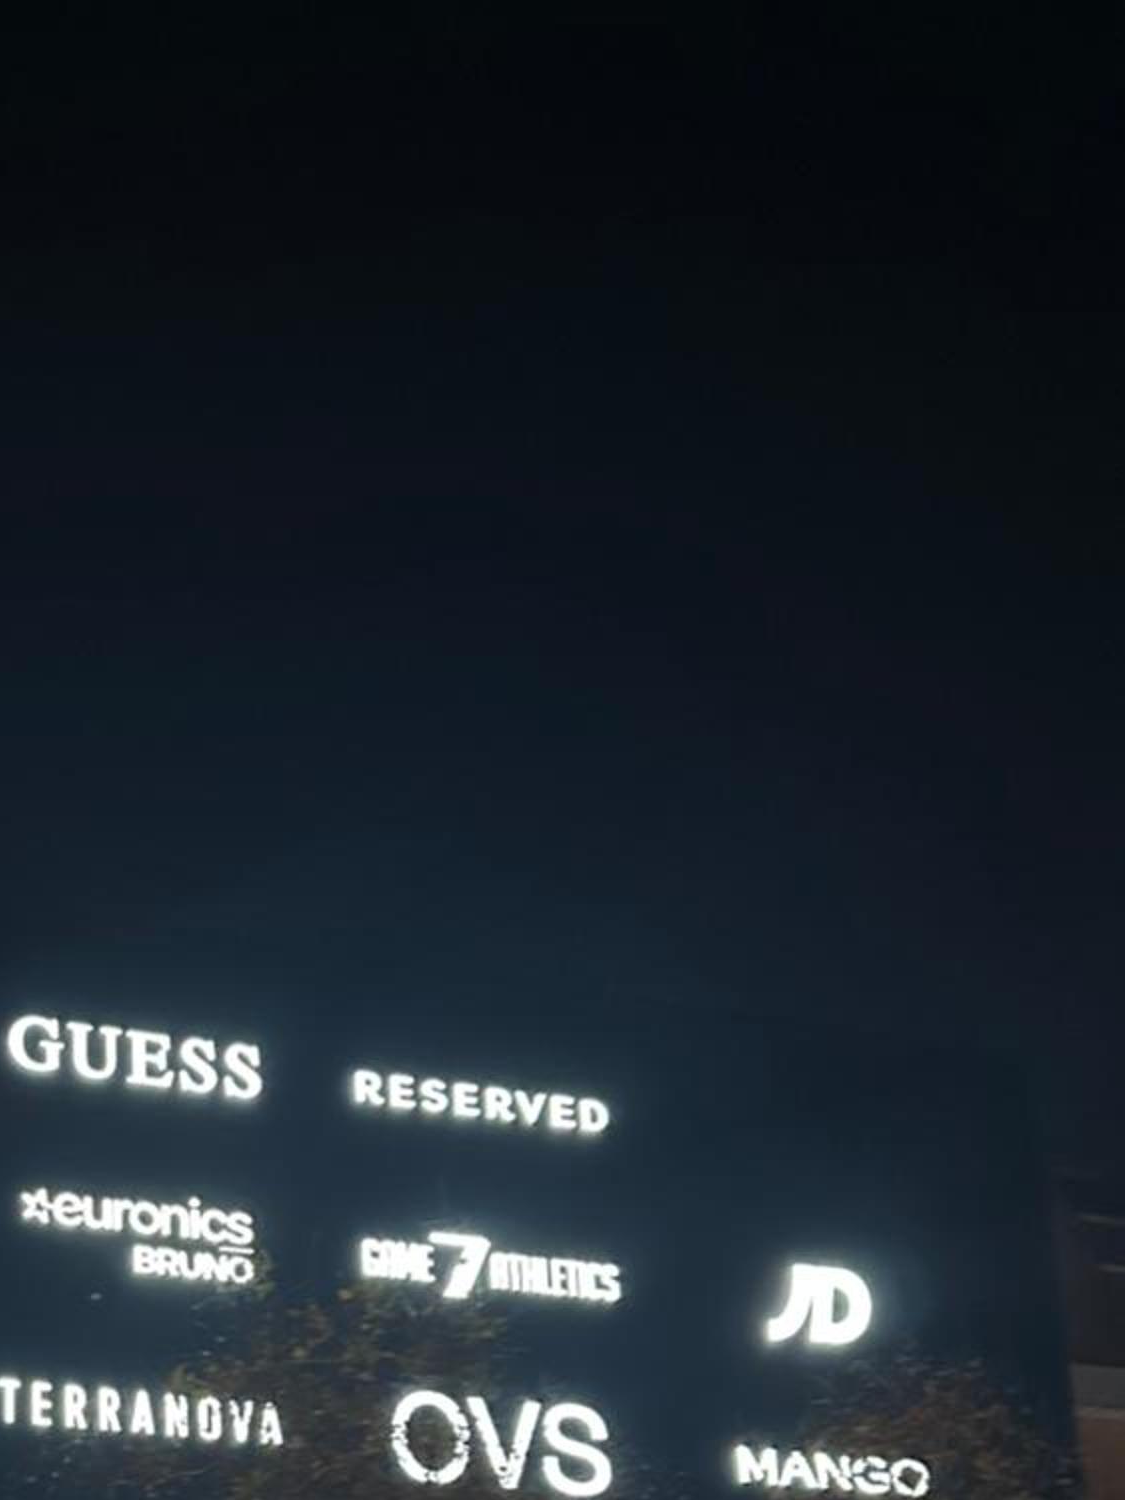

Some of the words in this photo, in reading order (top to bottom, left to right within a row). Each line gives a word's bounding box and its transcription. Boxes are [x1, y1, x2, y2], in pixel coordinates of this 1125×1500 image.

[6, 1014, 263, 1100] GUESS
[352, 1069, 610, 1134] RESERVED
[53, 1190, 254, 1244] euronics
[132, 1243, 254, 1284] BRUNO
[428, 1231, 491, 1299] 7
[765, 1263, 872, 1345] JD
[391, 1389, 612, 1498] OVS
[734, 1445, 931, 1498] MANGO
